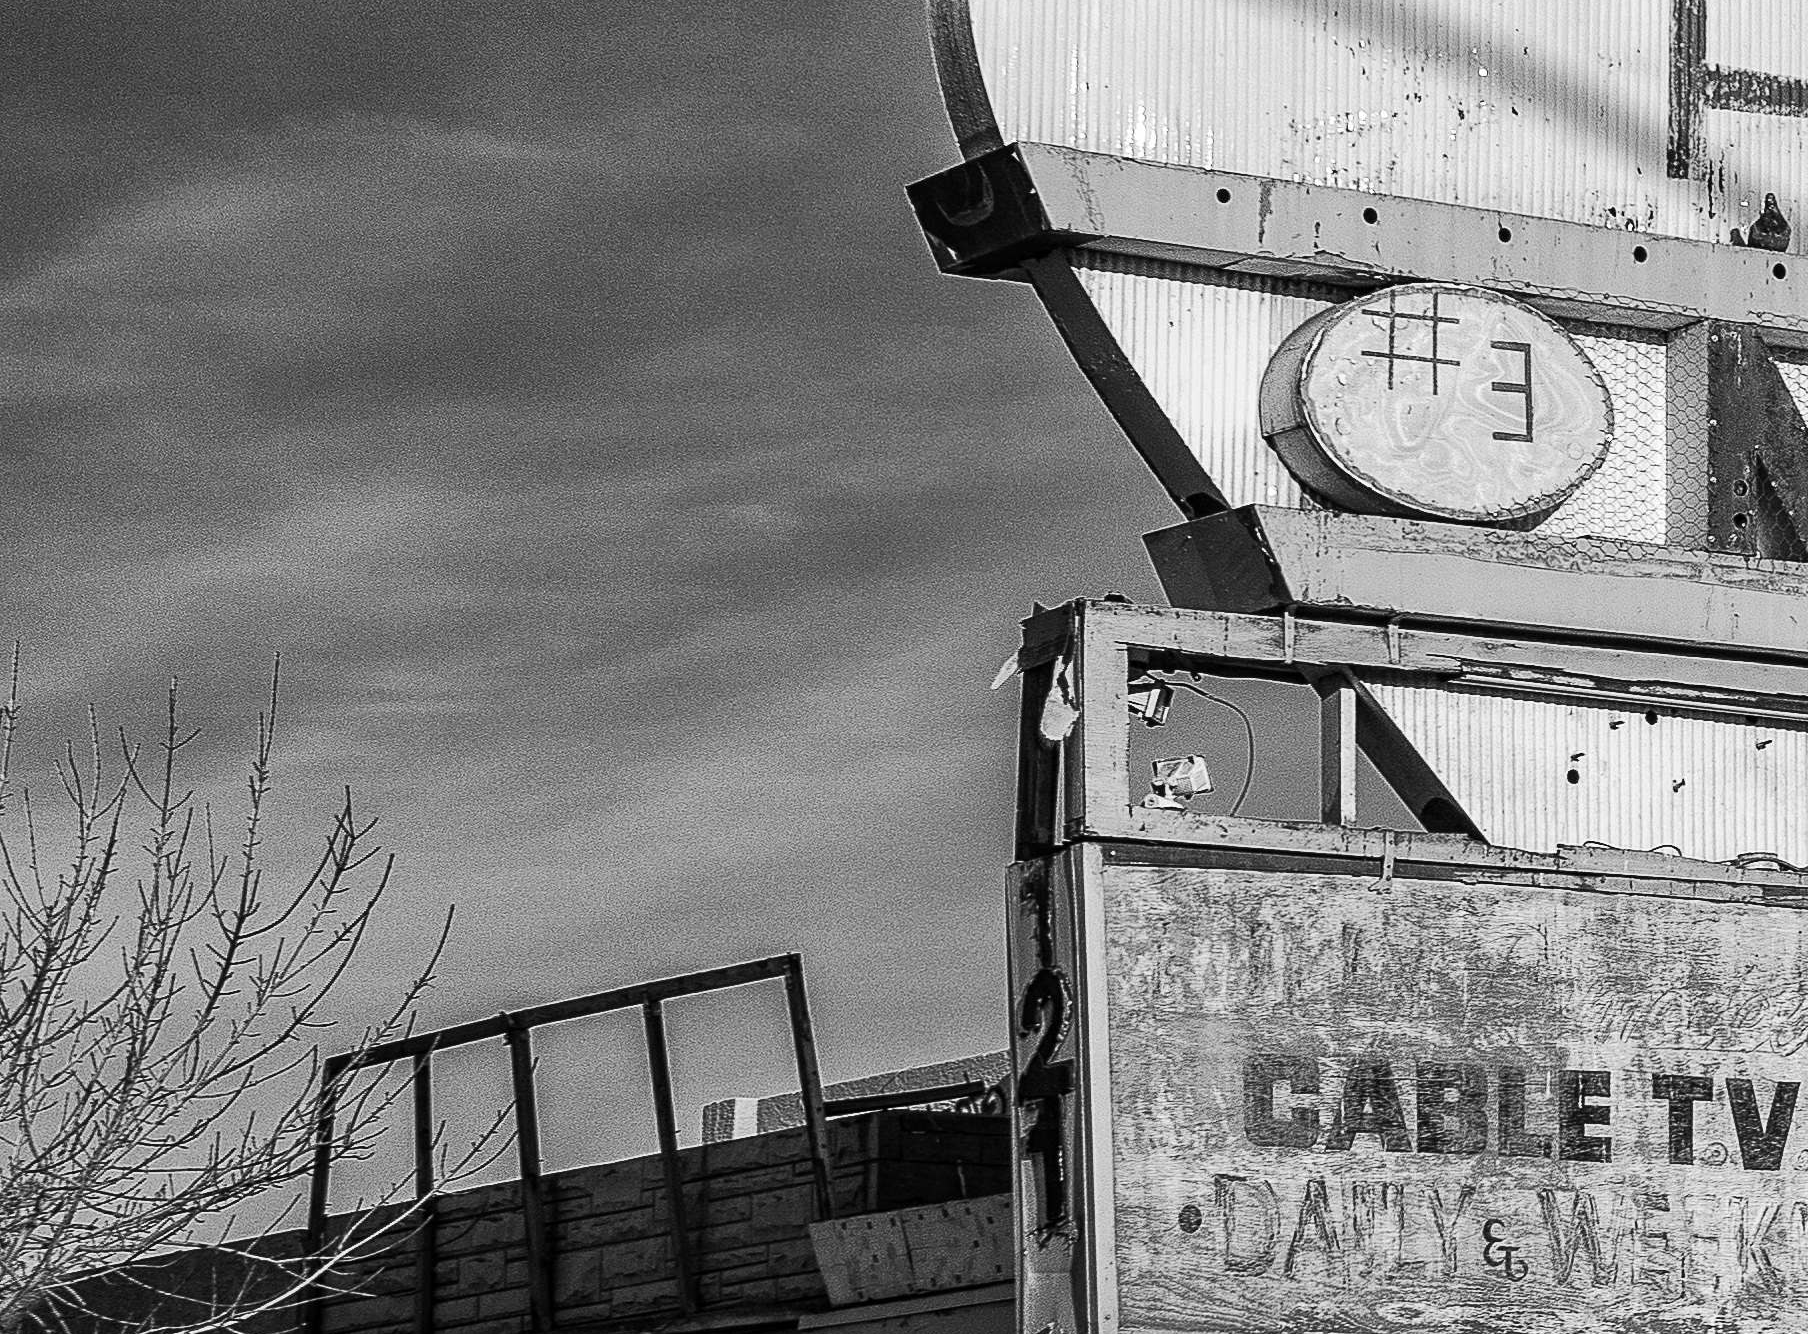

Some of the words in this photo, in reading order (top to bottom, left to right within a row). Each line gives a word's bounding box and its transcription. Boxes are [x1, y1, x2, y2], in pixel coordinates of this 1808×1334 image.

[1242, 1051, 1614, 1164] CABLE
[1214, 1172, 1476, 1278] DAILY
[1482, 1217, 1530, 1283] &
